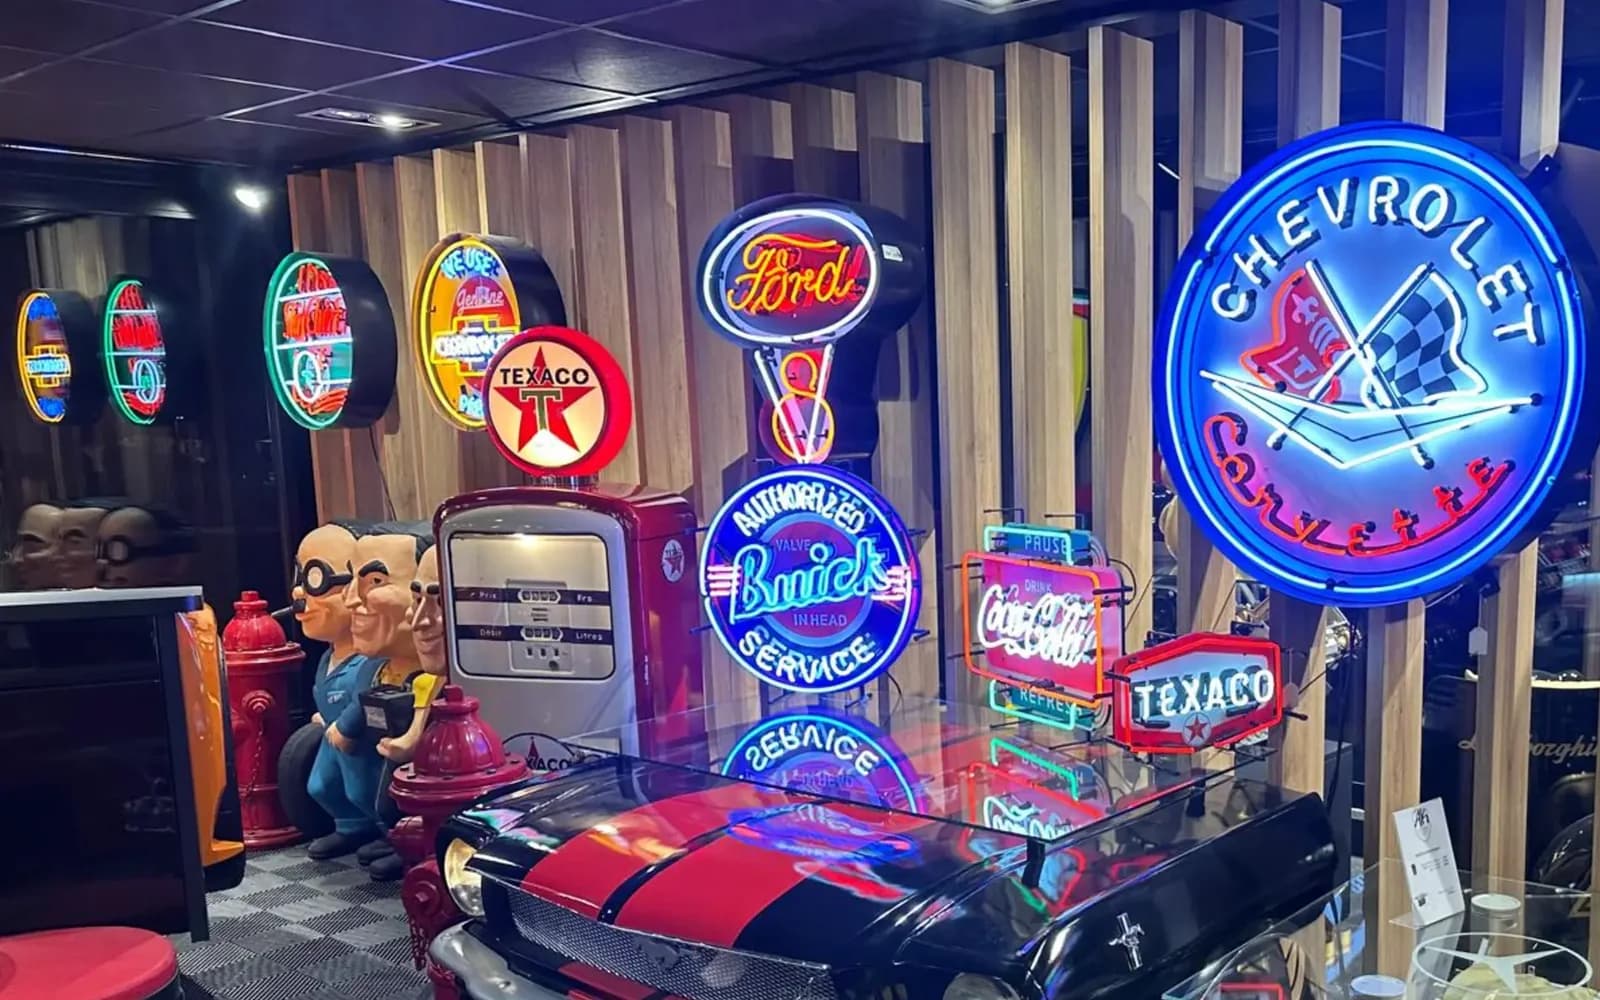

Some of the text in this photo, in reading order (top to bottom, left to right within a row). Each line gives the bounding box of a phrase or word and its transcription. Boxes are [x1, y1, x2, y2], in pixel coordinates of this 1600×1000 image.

[465, 247, 492, 276] USE
[725, 234, 858, 315] Ford
[1211, 176, 1538, 345] CHEVROLET
[500, 368, 589, 385] TEXACO
[732, 482, 867, 537] AUTHORIZED
[1203, 413, 1512, 559] Corvette
[775, 538, 812, 551] VALVE
[1024, 535, 1069, 554] PAUSE
[729, 536, 892, 625] Buick
[793, 613, 848, 626] IN HEAD
[738, 629, 877, 684] SERVICE
[1134, 669, 1275, 721] TEXACO
